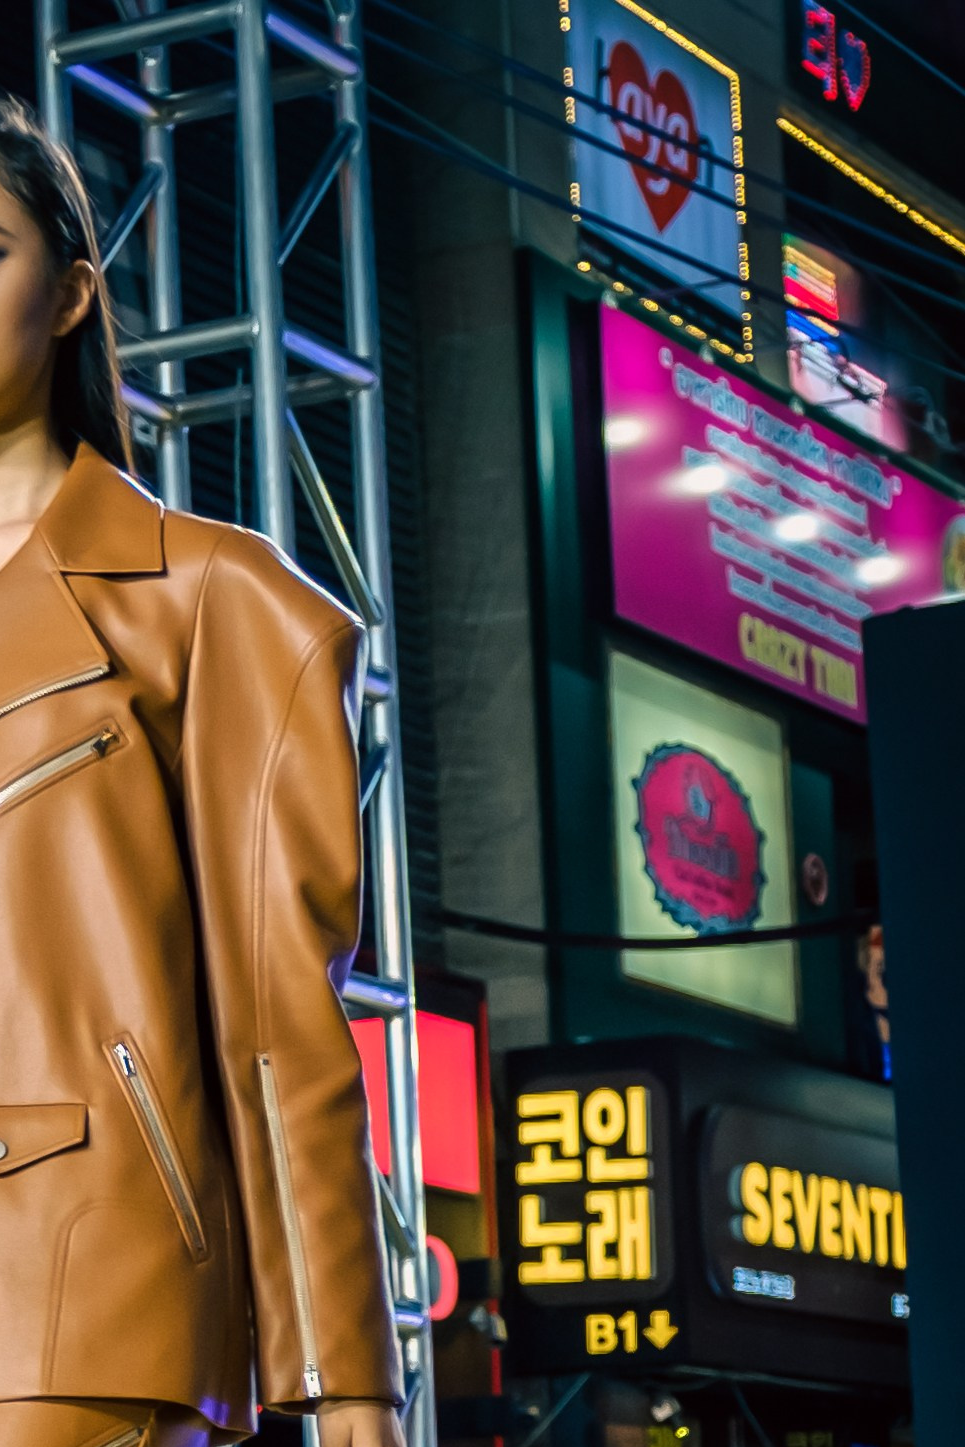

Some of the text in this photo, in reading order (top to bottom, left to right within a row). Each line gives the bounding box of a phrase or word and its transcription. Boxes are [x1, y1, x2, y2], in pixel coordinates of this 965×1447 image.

[515, 1086, 650, 1185] 코인
[518, 1187, 652, 1285] 노래
[585, 1310, 637, 1355] B1
